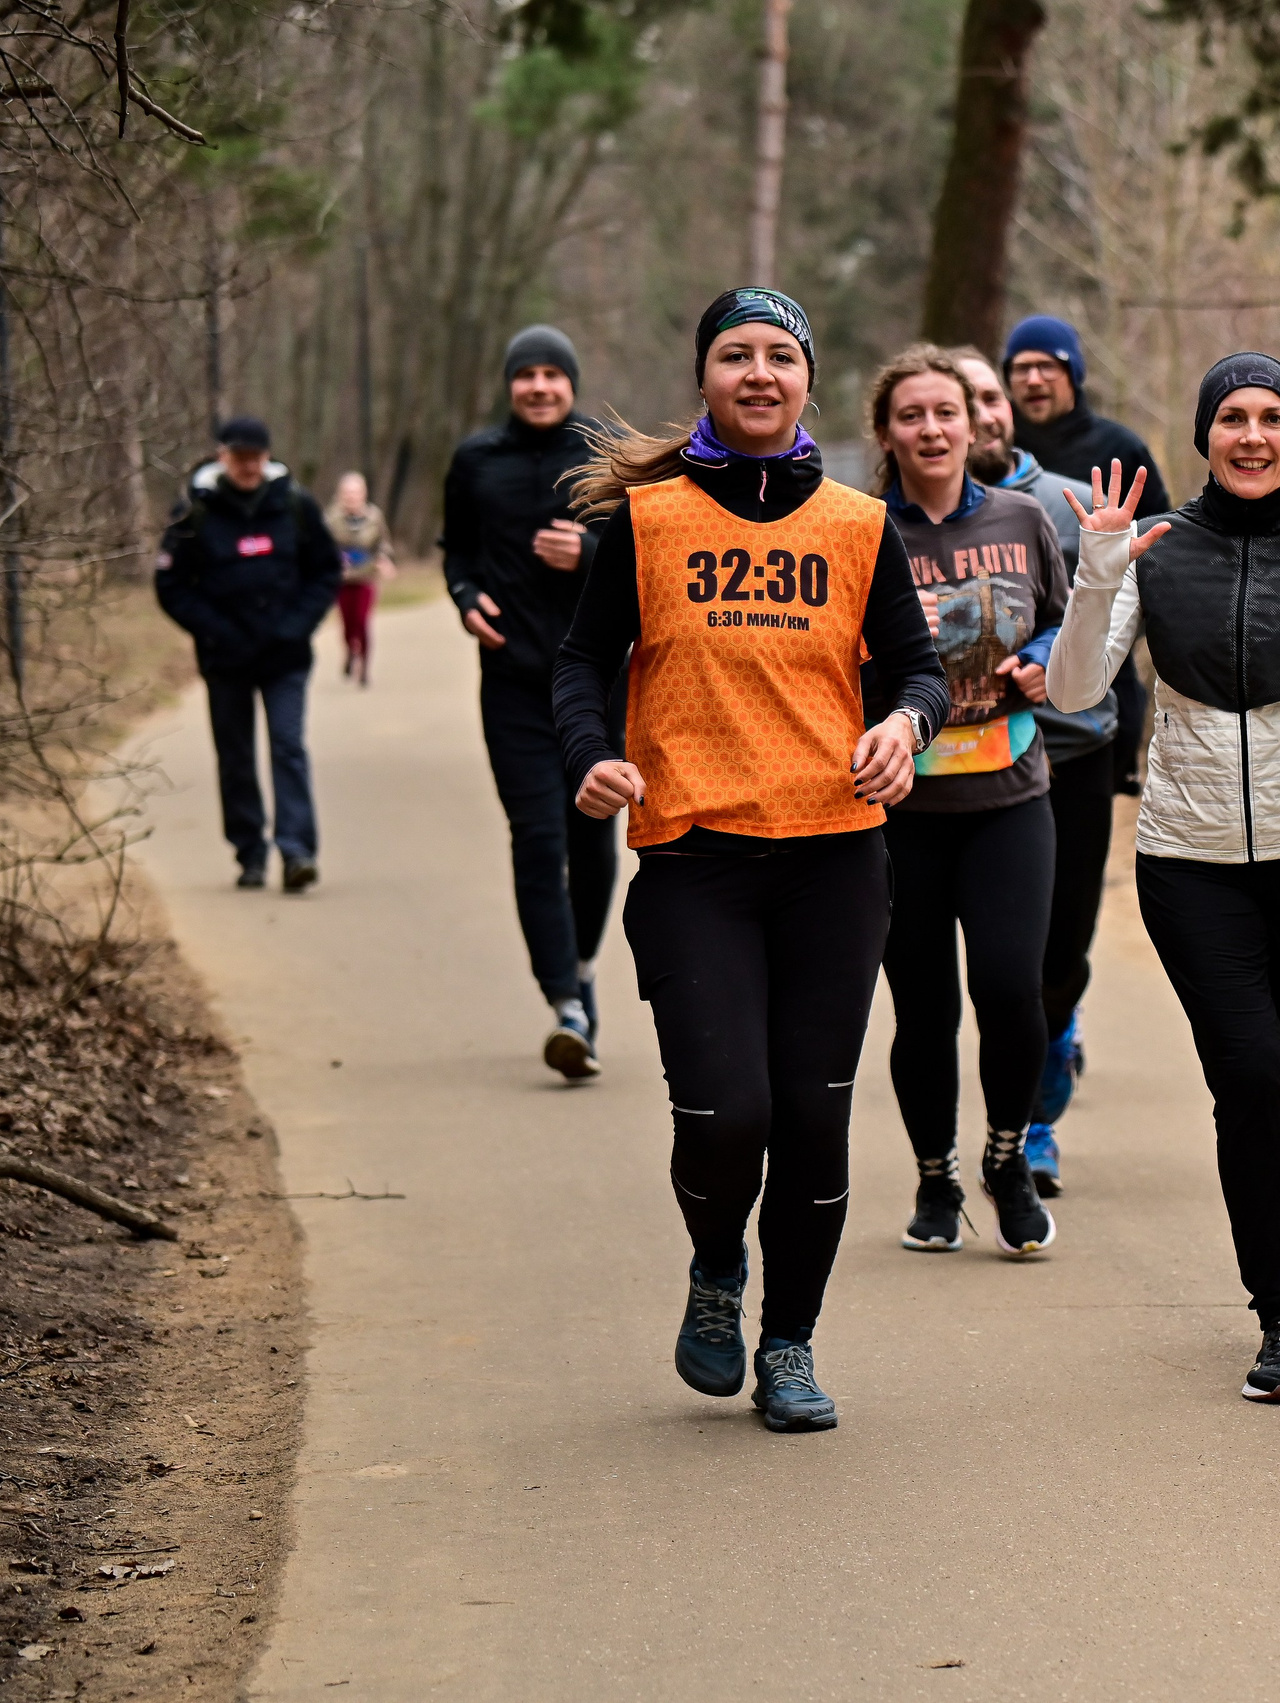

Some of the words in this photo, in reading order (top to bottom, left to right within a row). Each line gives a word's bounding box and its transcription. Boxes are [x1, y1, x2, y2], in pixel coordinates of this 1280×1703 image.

[687, 548, 829, 608] 32:30
[954, 542, 1028, 580] FLOYD
[707, 610, 743, 628] 6:30
